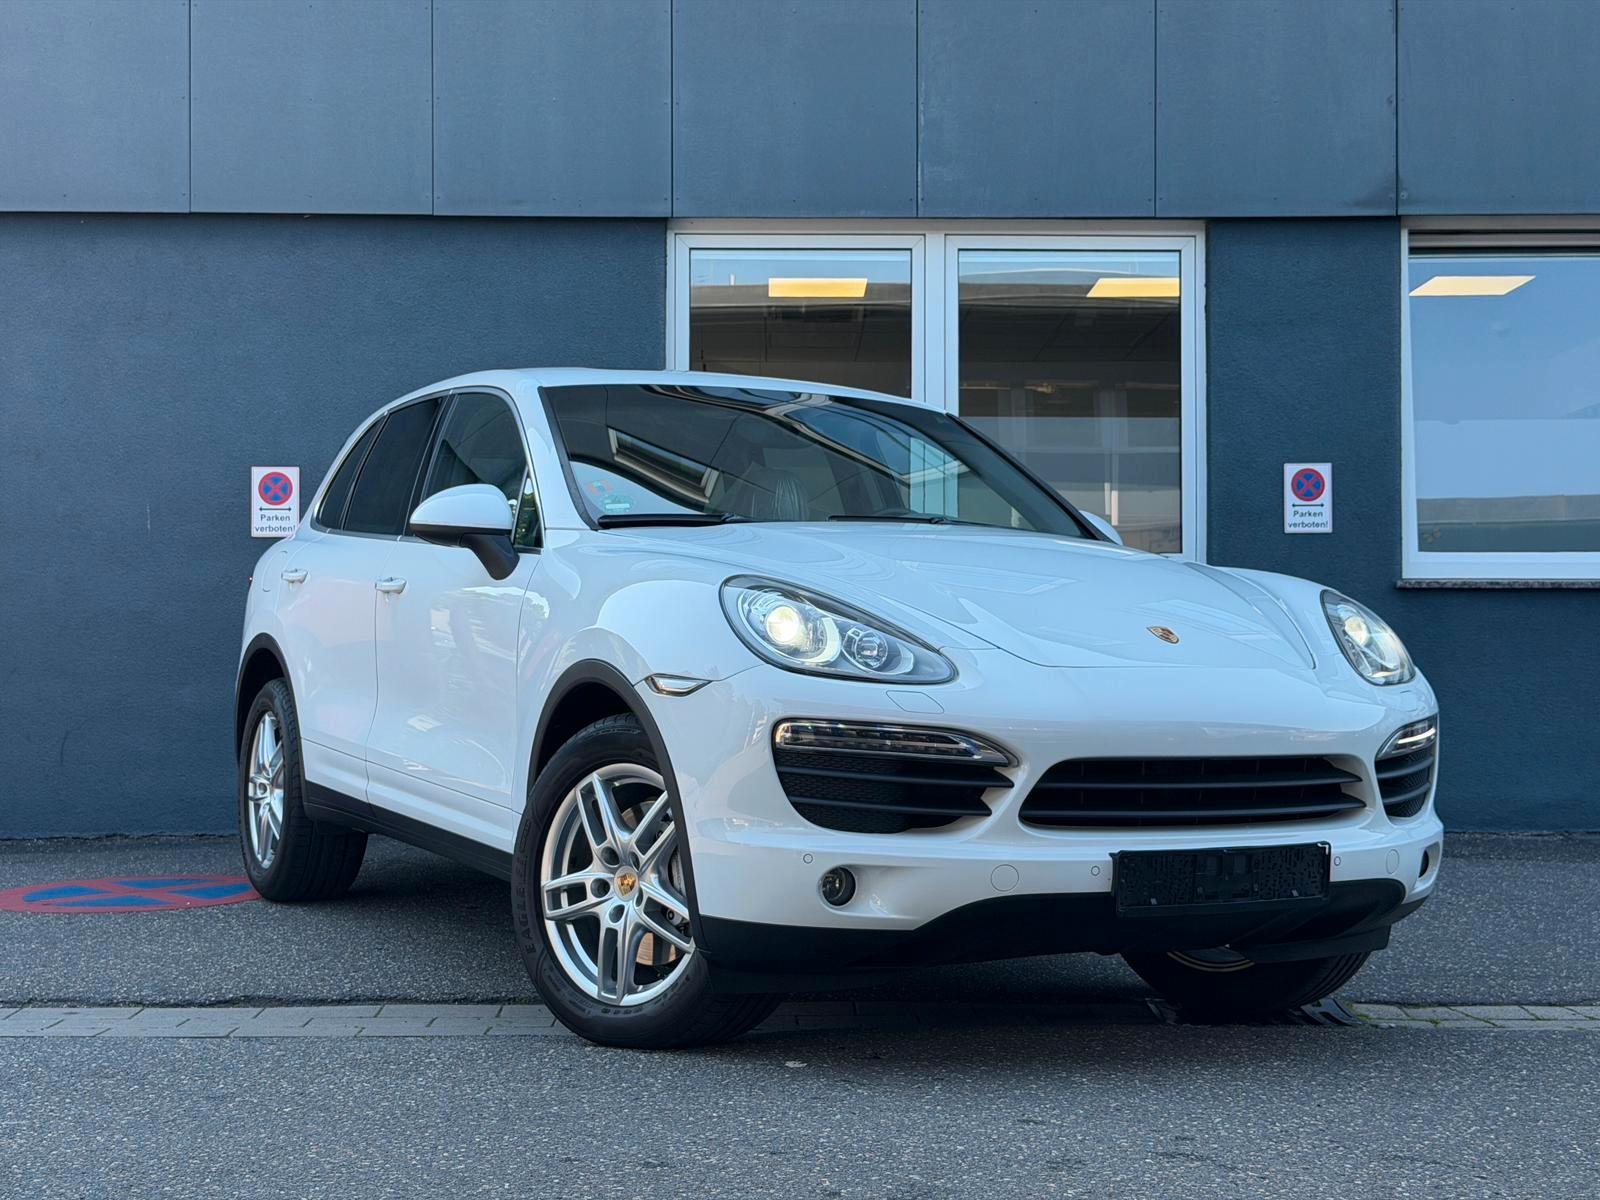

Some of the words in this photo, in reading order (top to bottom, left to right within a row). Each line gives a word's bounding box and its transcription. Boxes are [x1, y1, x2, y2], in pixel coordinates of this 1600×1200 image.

[260, 513, 291, 522] Parken
[1293, 510, 1324, 518] Parken
[255, 524, 296, 533] verboten!
[1288, 520, 1329, 529] verboten!
